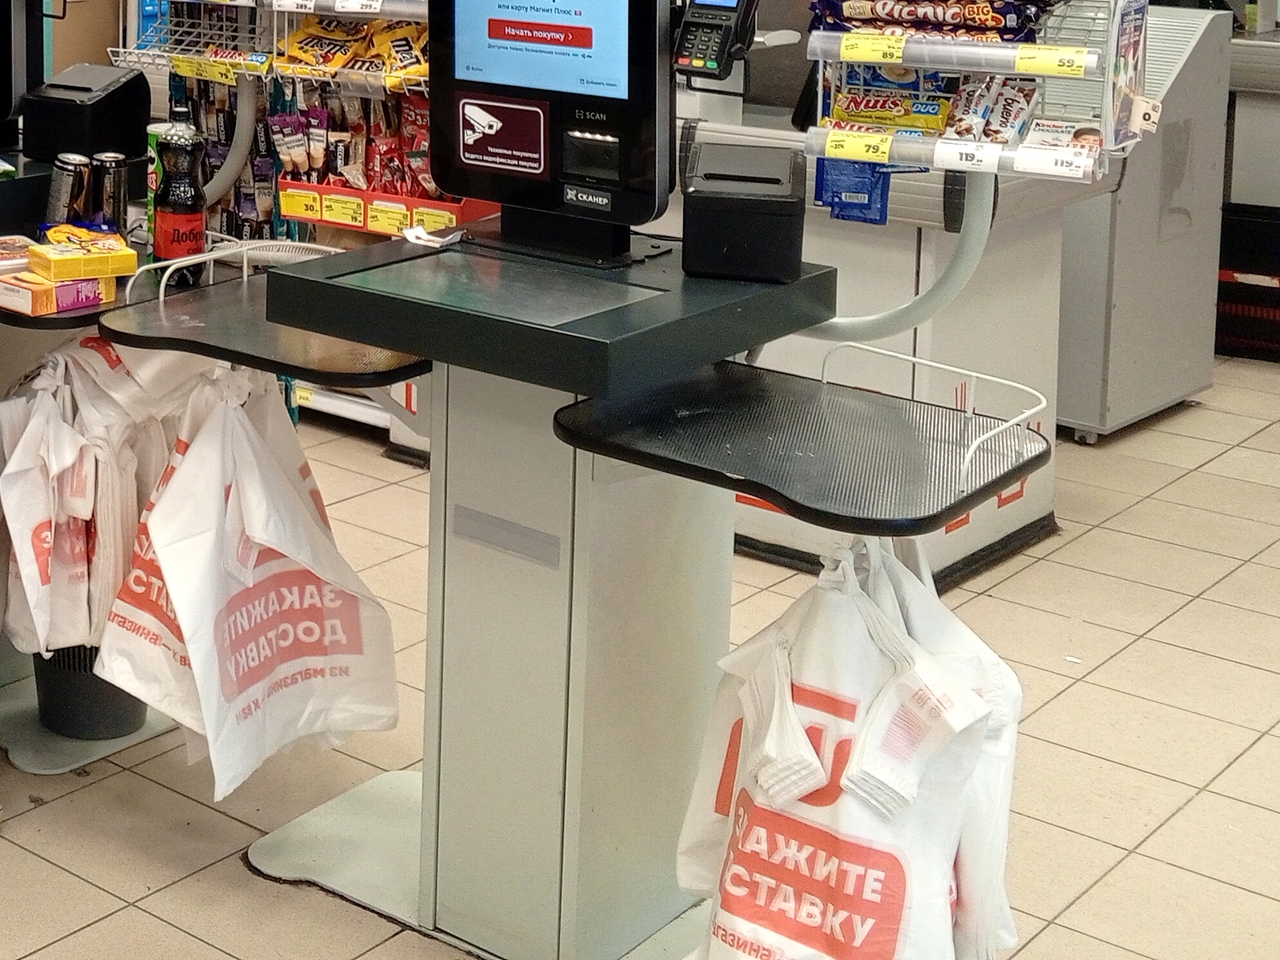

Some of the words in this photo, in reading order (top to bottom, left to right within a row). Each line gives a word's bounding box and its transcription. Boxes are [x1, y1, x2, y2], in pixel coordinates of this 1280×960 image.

[510, 4, 528, 13] карту
[530, 5, 552, 14] Магнит
[554, 7, 572, 15] Плюс
[967, 5, 991, 16] BIG
[505, 26, 532, 37] Начать
[533, 29, 565, 42] покупку
[845, 96, 902, 112] Nuts
[912, 103, 939, 114] DUO
[586, 112, 607, 121] SCAN
[487, 146, 512, 156] Уважаемые
[577, 192, 609, 207] СКАНЕР
[723, 861, 877, 948] СТАВКУ
